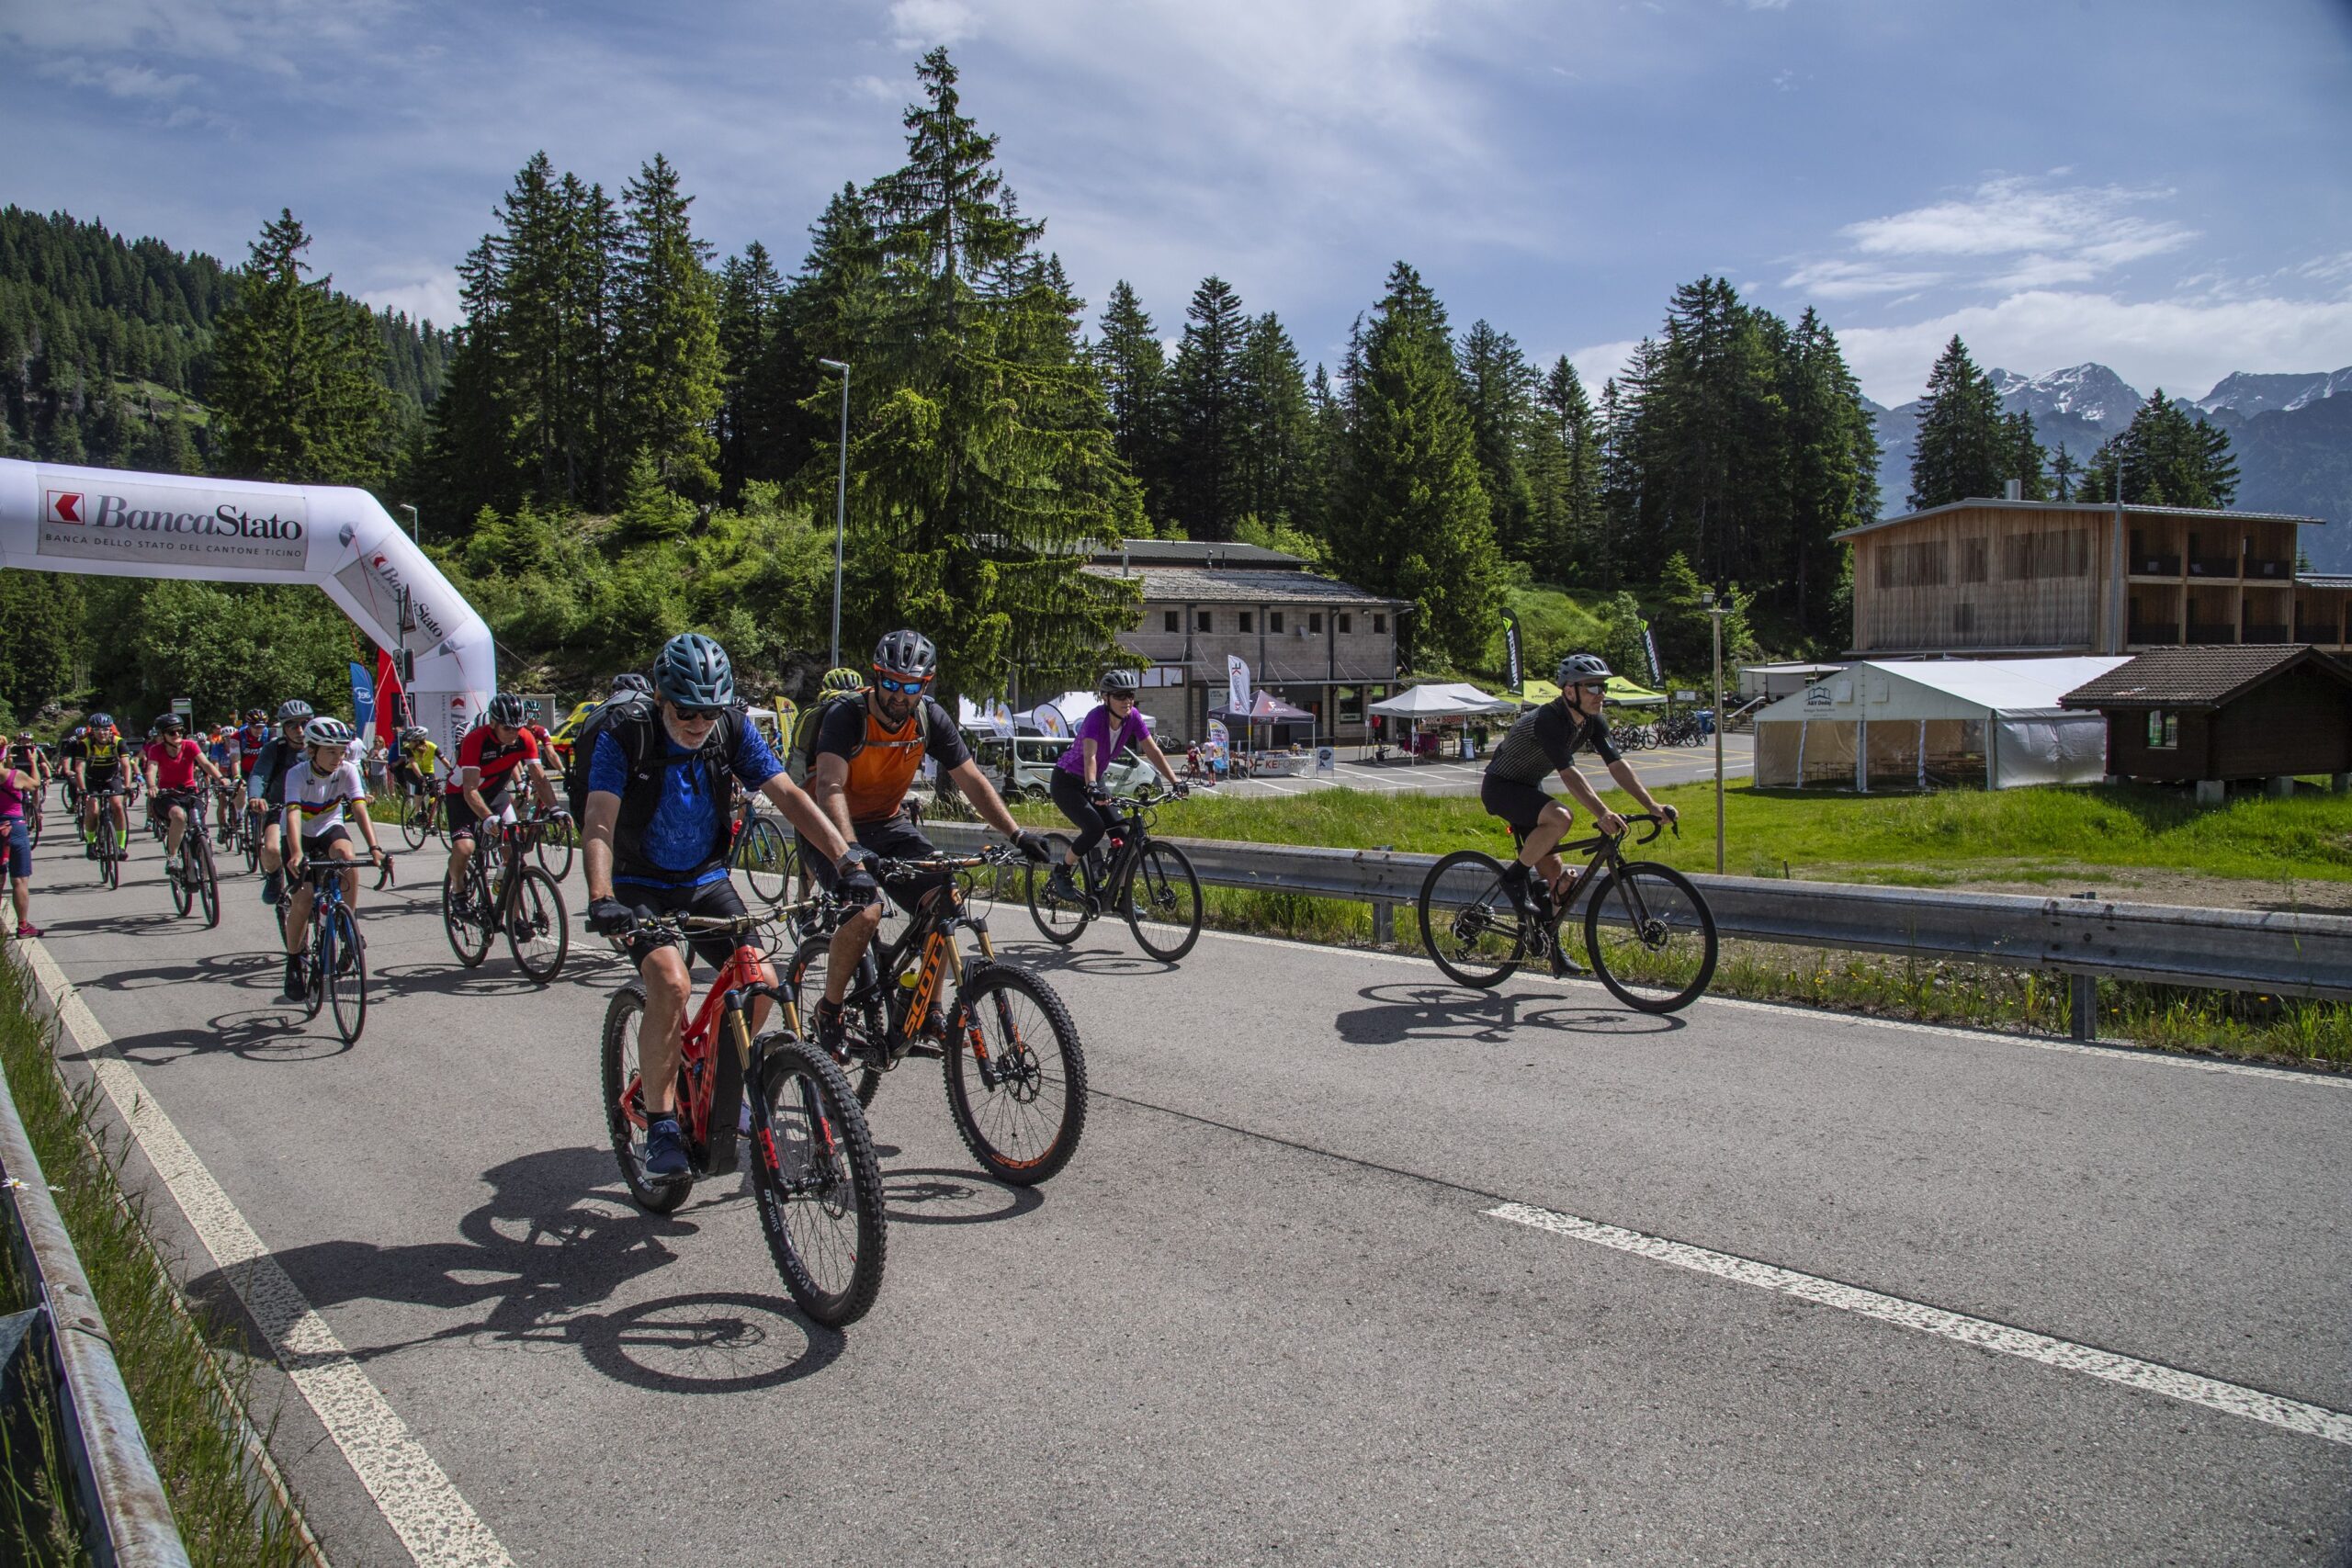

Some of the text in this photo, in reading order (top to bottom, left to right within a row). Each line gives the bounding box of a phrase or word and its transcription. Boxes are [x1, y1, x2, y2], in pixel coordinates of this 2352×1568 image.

[92, 494, 302, 540] BancaStato
[45, 534, 87, 545] BANCA
[94, 537, 132, 547] DELLO
[138, 541, 175, 550] STATO
[206, 545, 259, 555] CANTONE
[265, 548, 301, 558] TICINO
[903, 935, 944, 1038] SCOTT
[764, 1189, 781, 1232] DT SWISS
